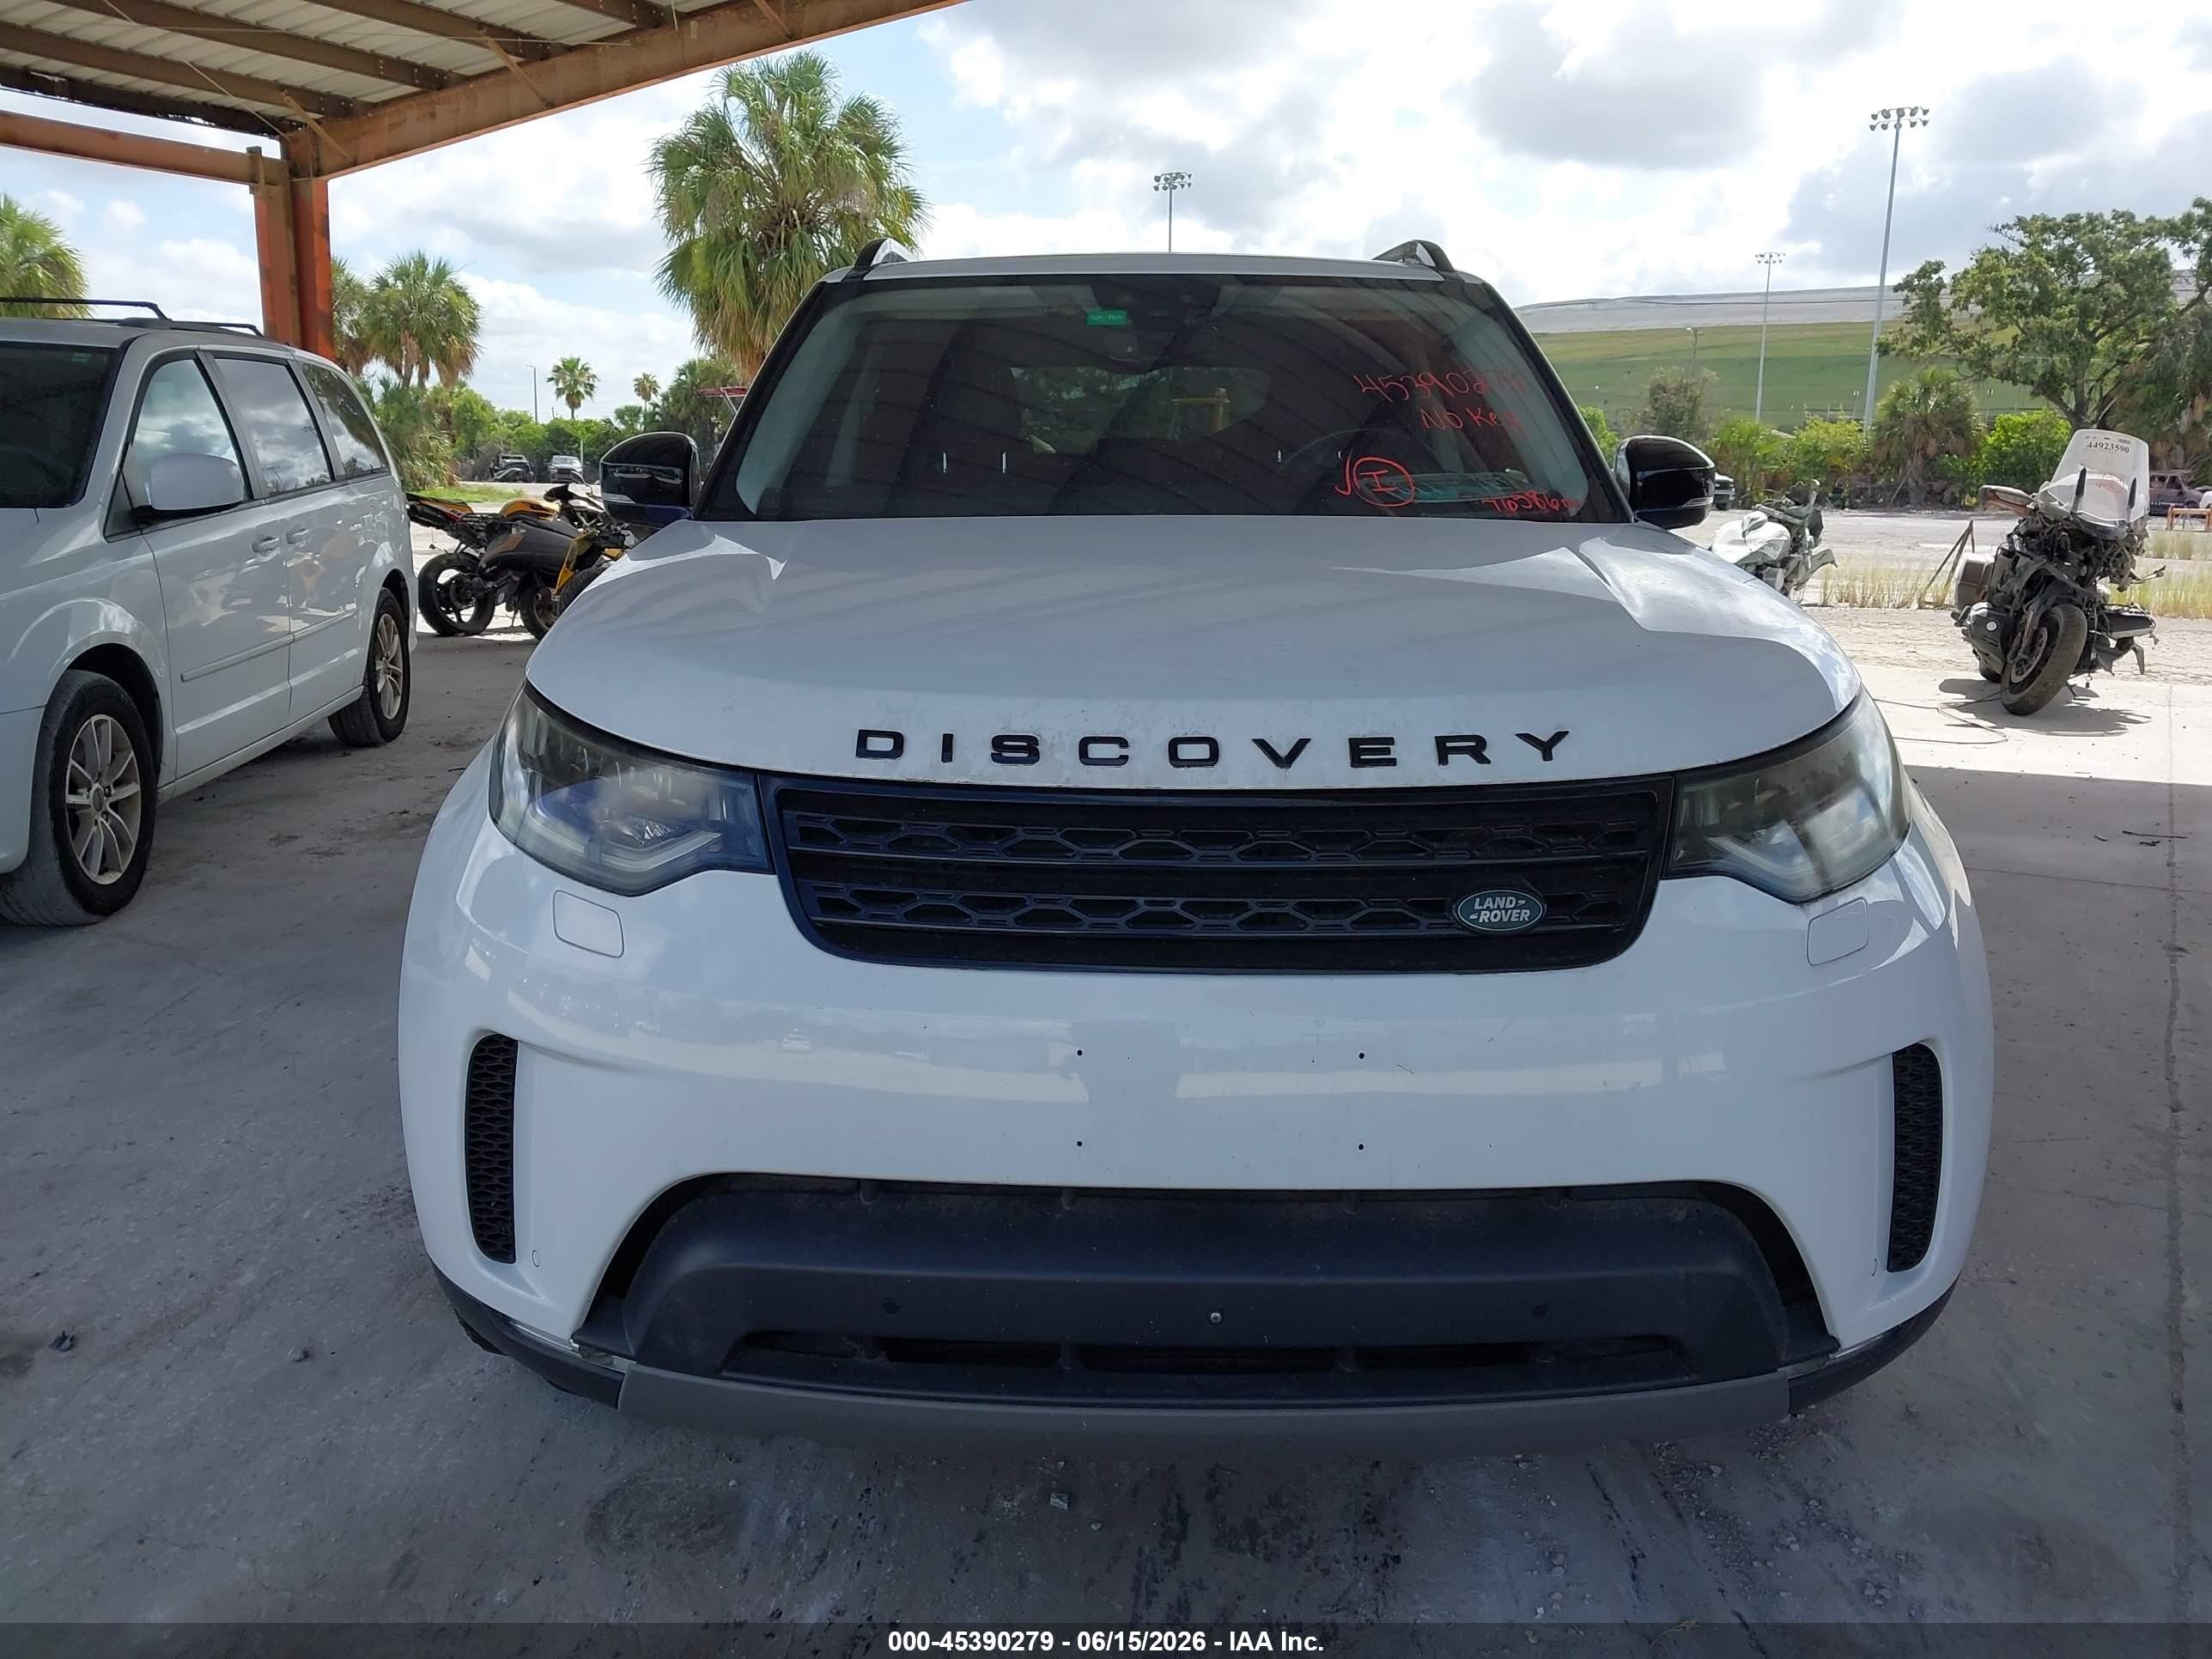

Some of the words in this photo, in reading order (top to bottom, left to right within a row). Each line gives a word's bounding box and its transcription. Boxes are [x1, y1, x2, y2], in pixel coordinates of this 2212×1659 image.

[2087, 441, 2130, 453] 44923590
[856, 730, 1569, 768] DISCOVERY
[1474, 896, 1516, 910] LAND
[1479, 909, 1531, 923] ROVER
